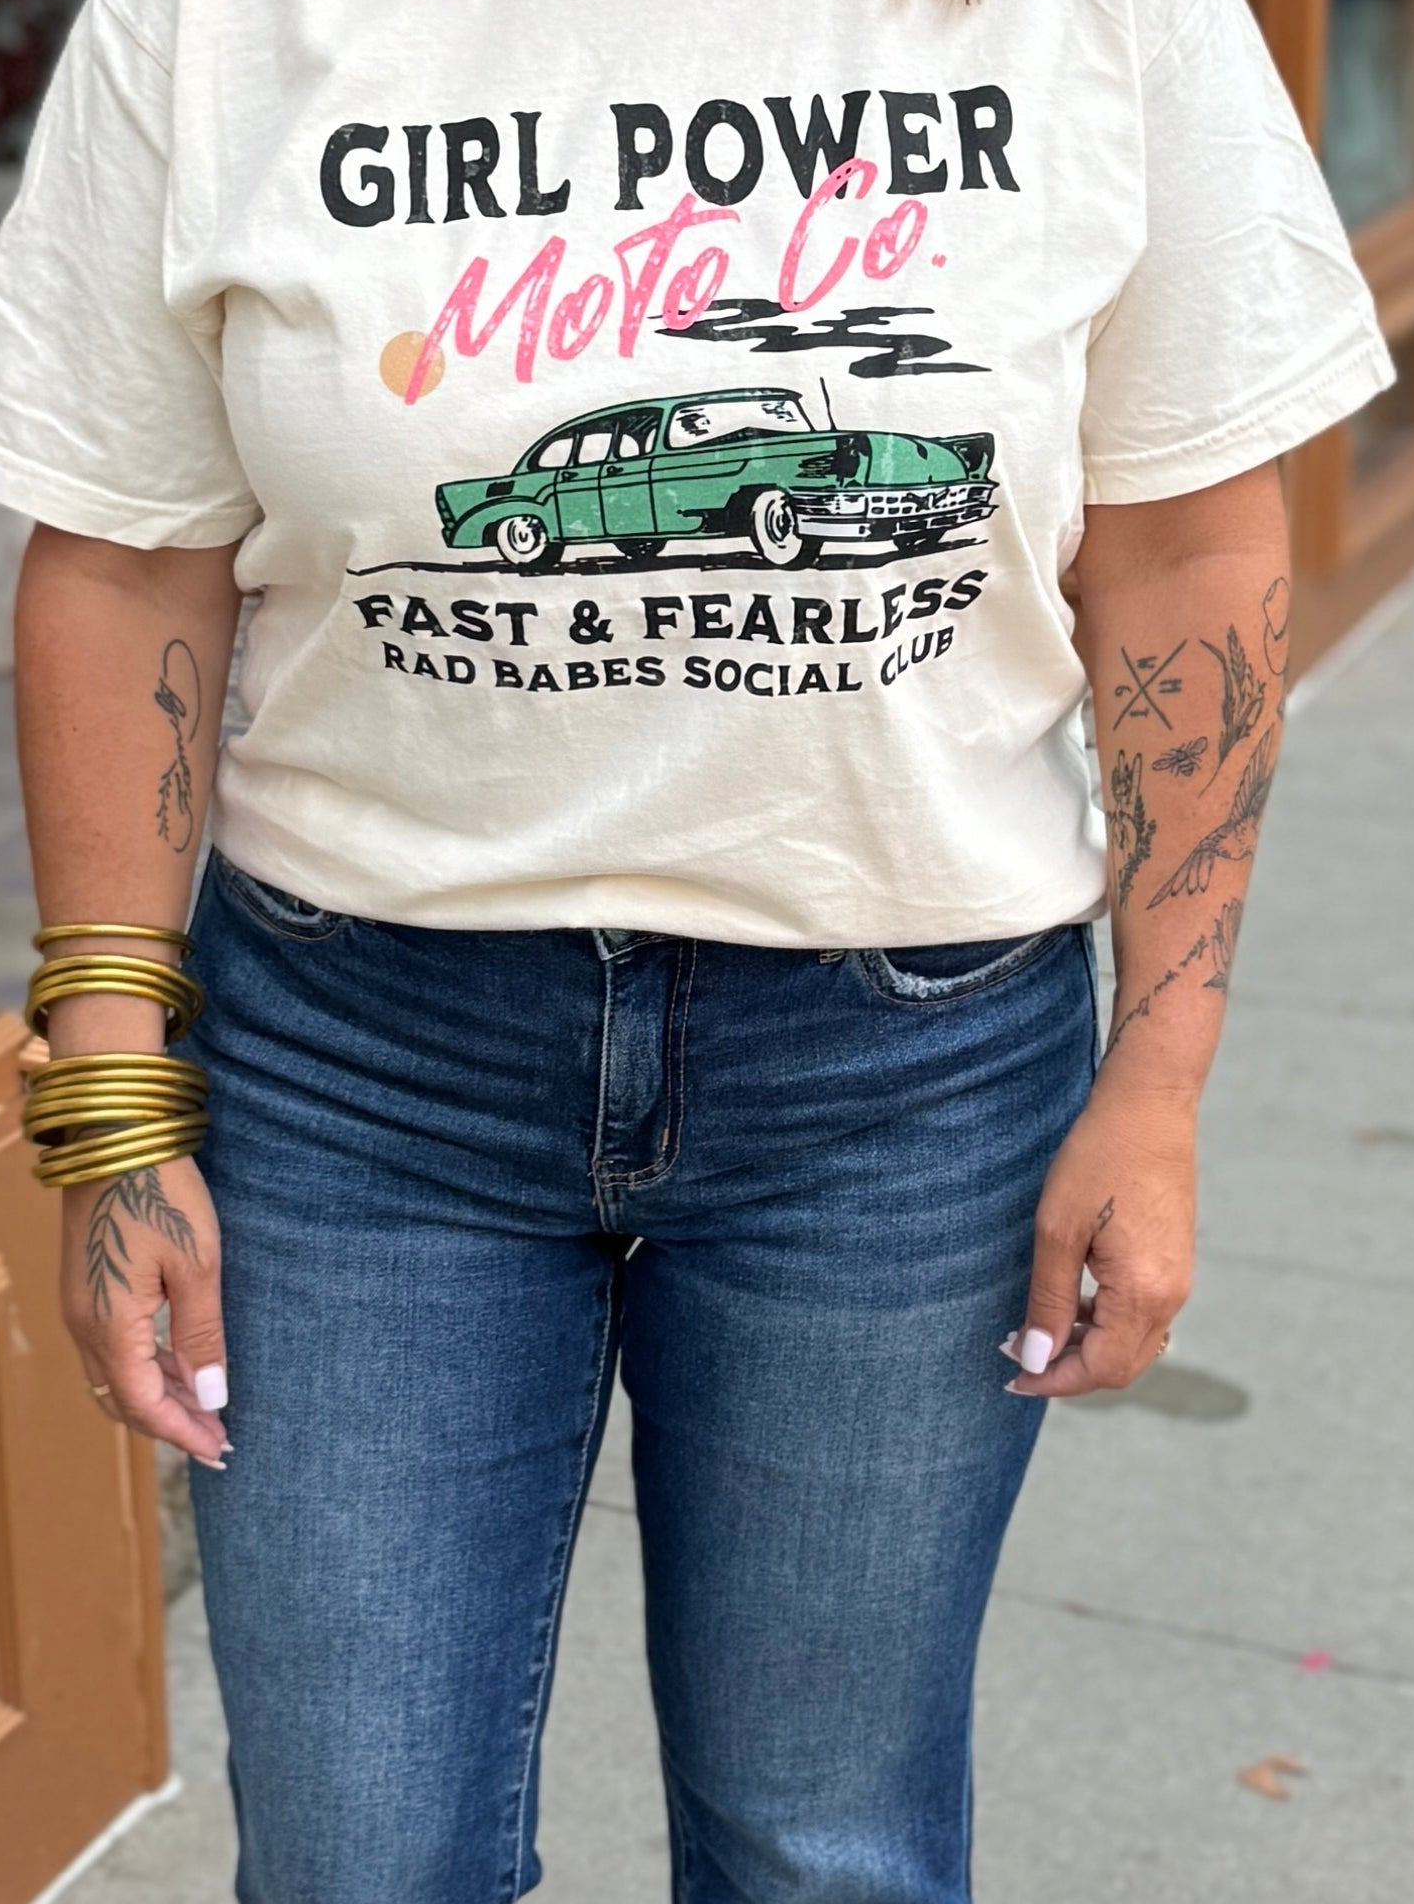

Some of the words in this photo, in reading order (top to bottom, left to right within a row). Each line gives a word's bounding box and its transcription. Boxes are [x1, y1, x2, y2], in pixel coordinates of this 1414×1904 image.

[319, 111, 572, 228] GIRL
[608, 84, 1021, 211] POWER
[779, 155, 948, 313] Co.
[353, 593, 538, 646] FAST
[569, 601, 613, 644] &
[641, 568, 989, 645] FEARLESS
[380, 639, 476, 686] RAD
[494, 654, 666, 693] BABES
[683, 655, 862, 696] SOCIAL
[879, 626, 956, 688] CLUB
